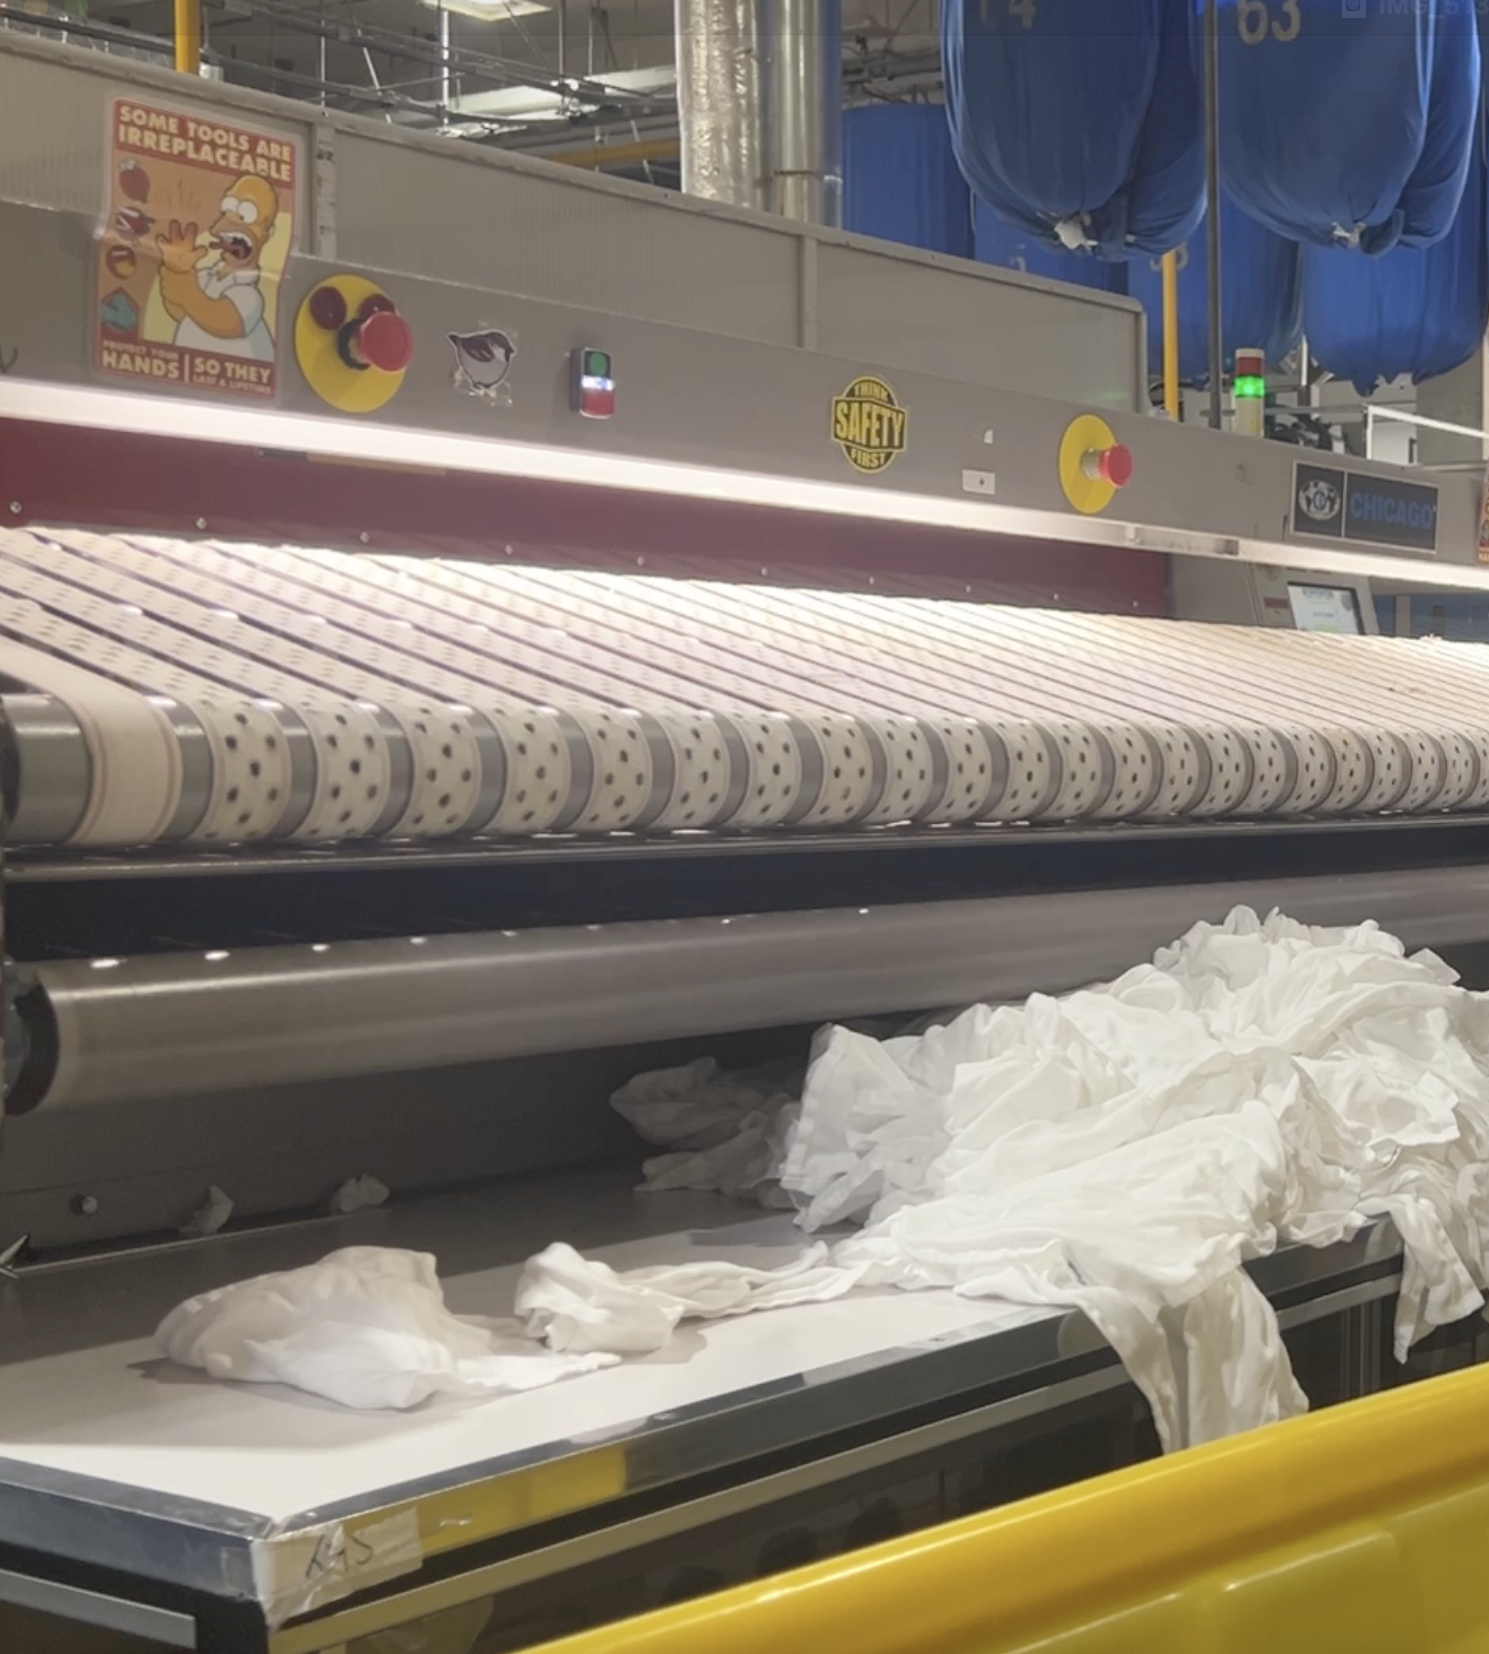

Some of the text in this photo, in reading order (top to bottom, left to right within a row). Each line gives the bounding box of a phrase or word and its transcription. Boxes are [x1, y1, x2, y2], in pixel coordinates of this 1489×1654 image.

[1237, 0, 1300, 45] 63
[118, 123, 291, 181] IRREPLACEABLE
[119, 105, 291, 162] SOME TOOLS ARE
[102, 350, 179, 379] HANDS
[194, 357, 271, 383] SO THEY
[855, 381, 889, 402] THINK
[836, 401, 903, 447] SAFETY
[851, 448, 886, 468] FIRST
